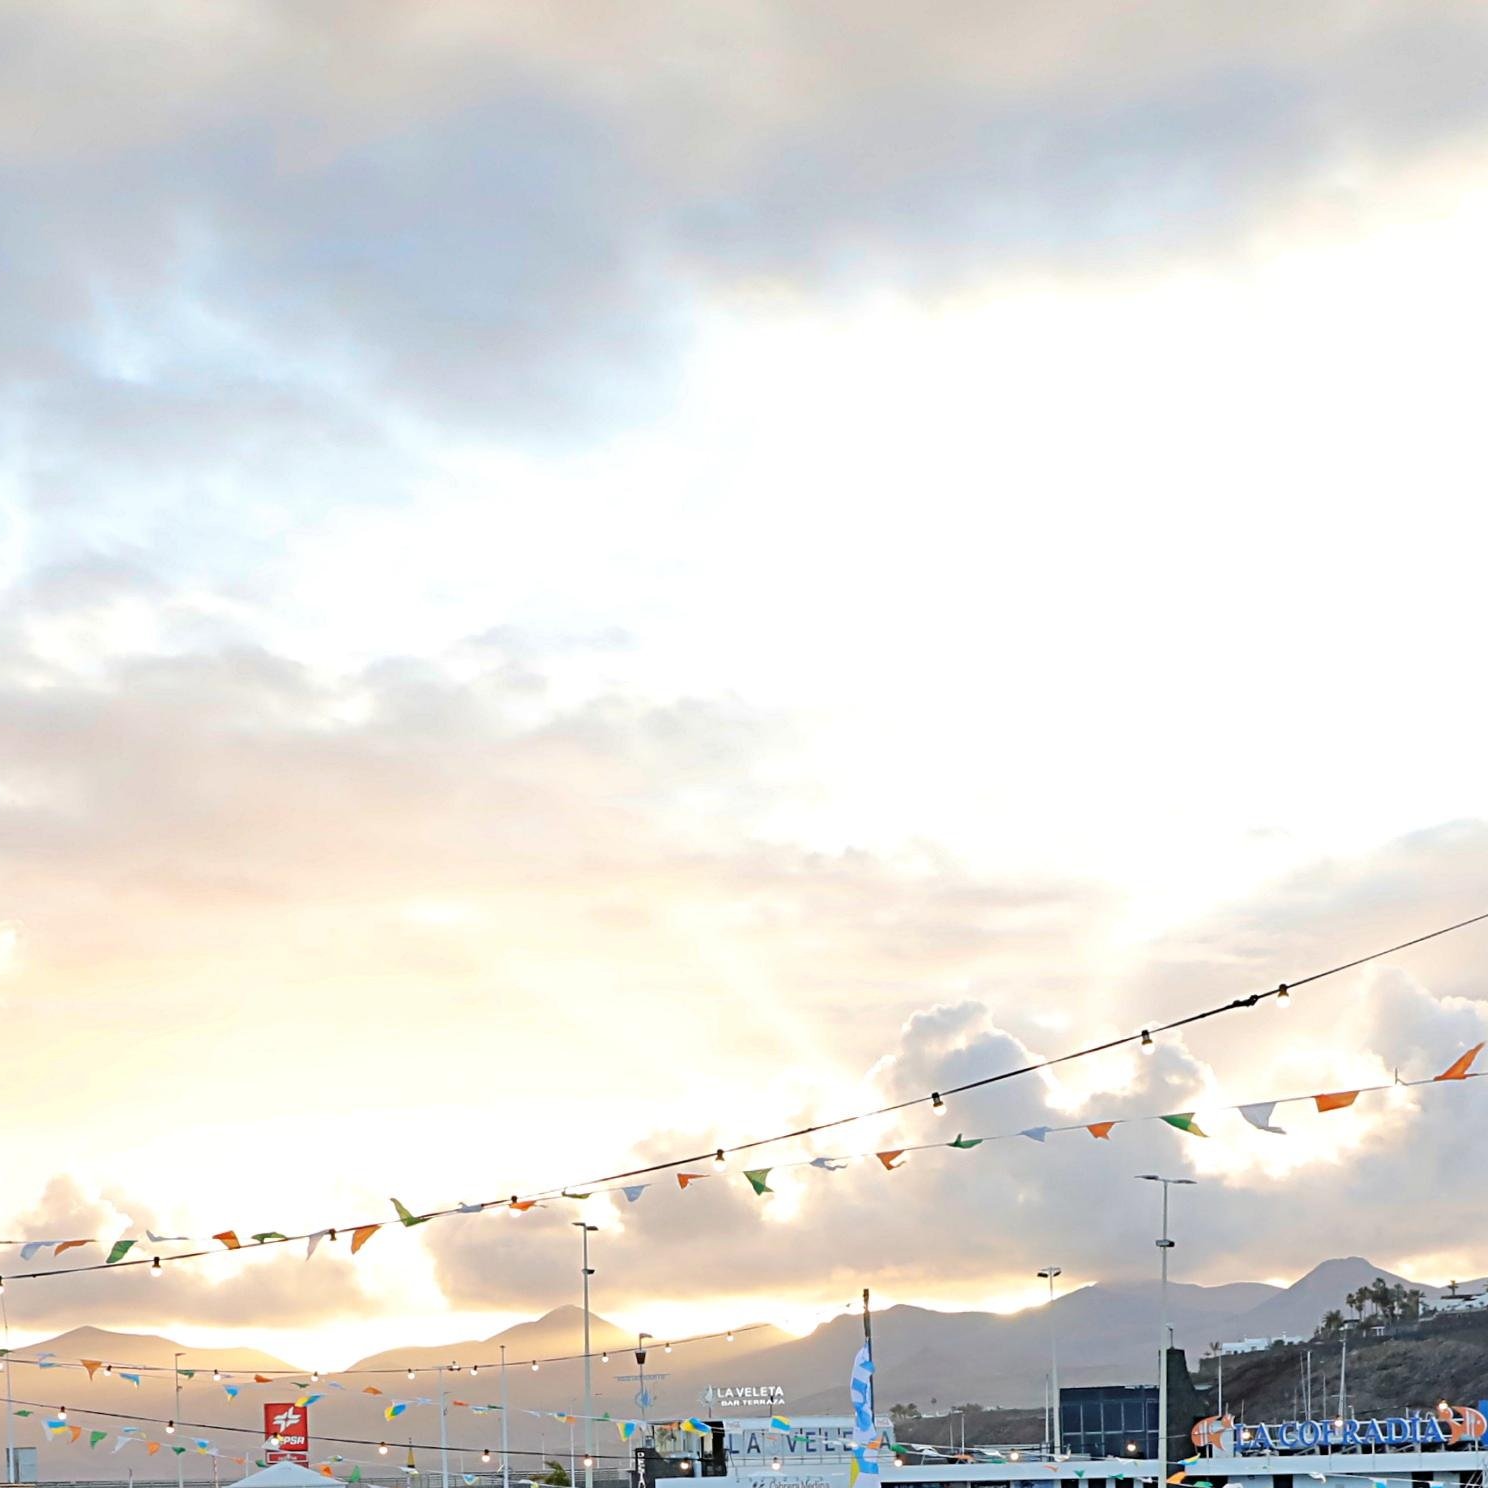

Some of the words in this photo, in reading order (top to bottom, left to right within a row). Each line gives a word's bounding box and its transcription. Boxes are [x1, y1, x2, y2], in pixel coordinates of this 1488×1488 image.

[717, 1387, 733, 1398] LA
[736, 1386, 784, 1398] VELETA
[729, 1432, 761, 1454] LA
[786, 1430, 892, 1453] VELEA
[1235, 1423, 1275, 1450] LA
